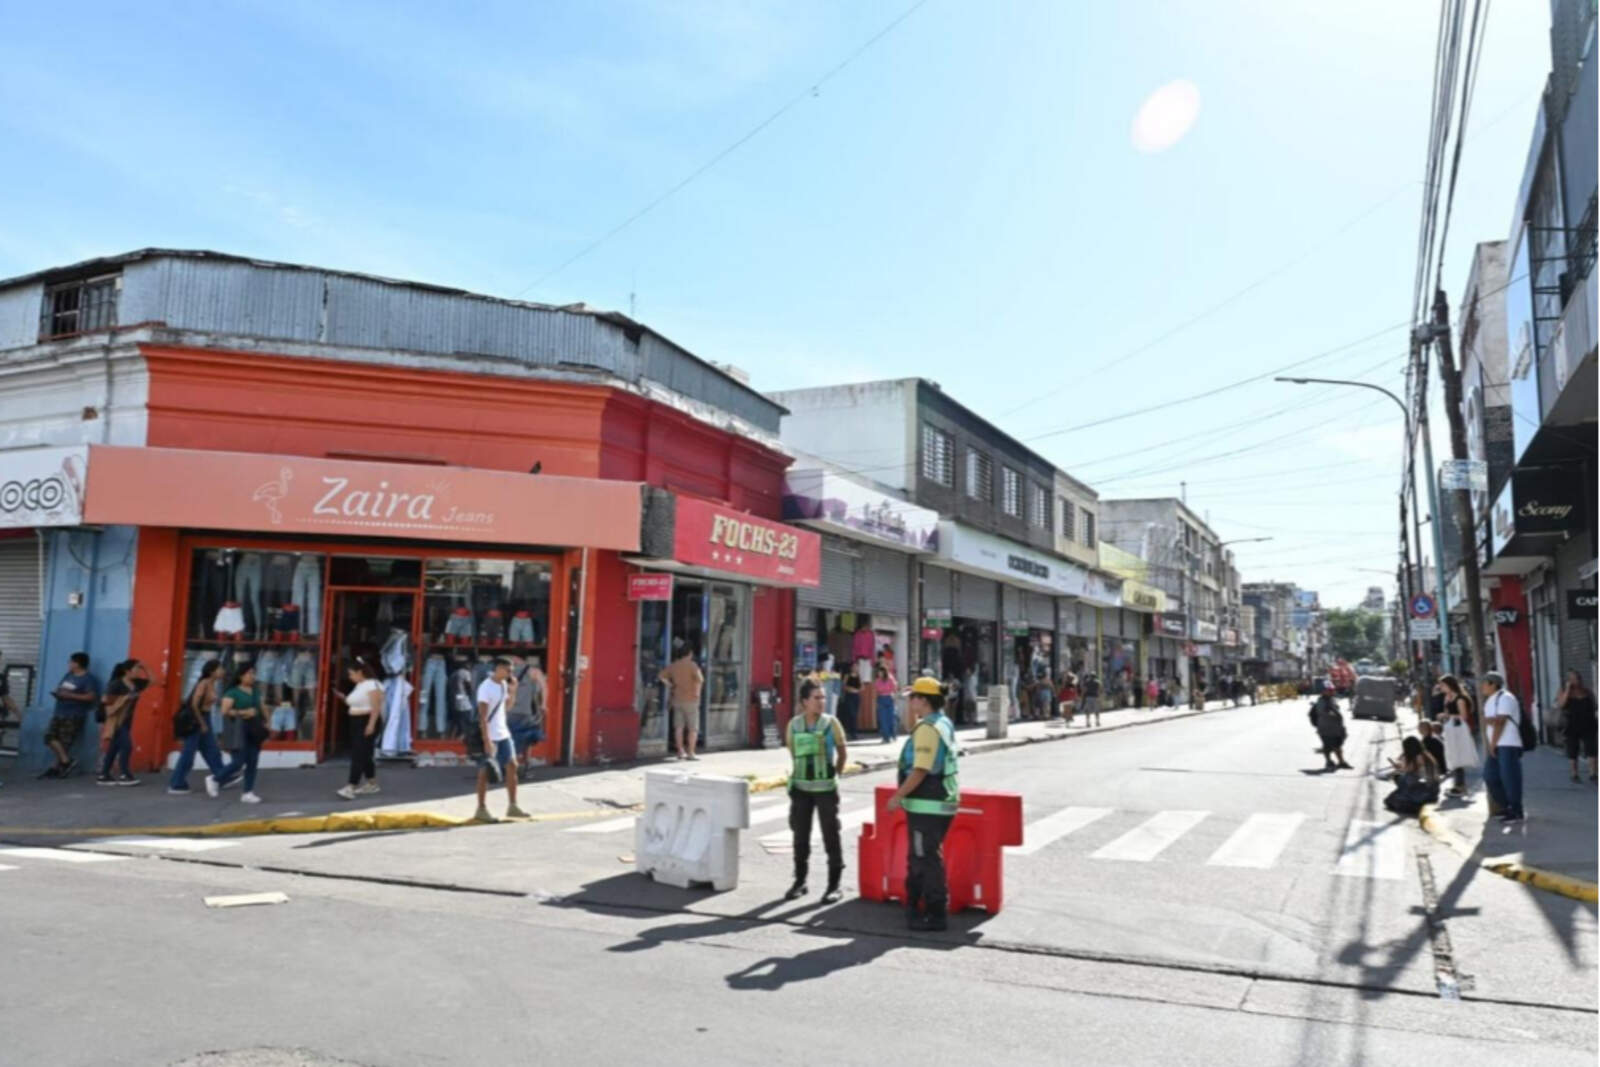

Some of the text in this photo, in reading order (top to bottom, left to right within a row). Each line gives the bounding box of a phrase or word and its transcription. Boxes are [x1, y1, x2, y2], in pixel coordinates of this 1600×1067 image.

[313, 476, 494, 523] Zaira Jeans
[709, 513, 798, 560] FOCHS-23
